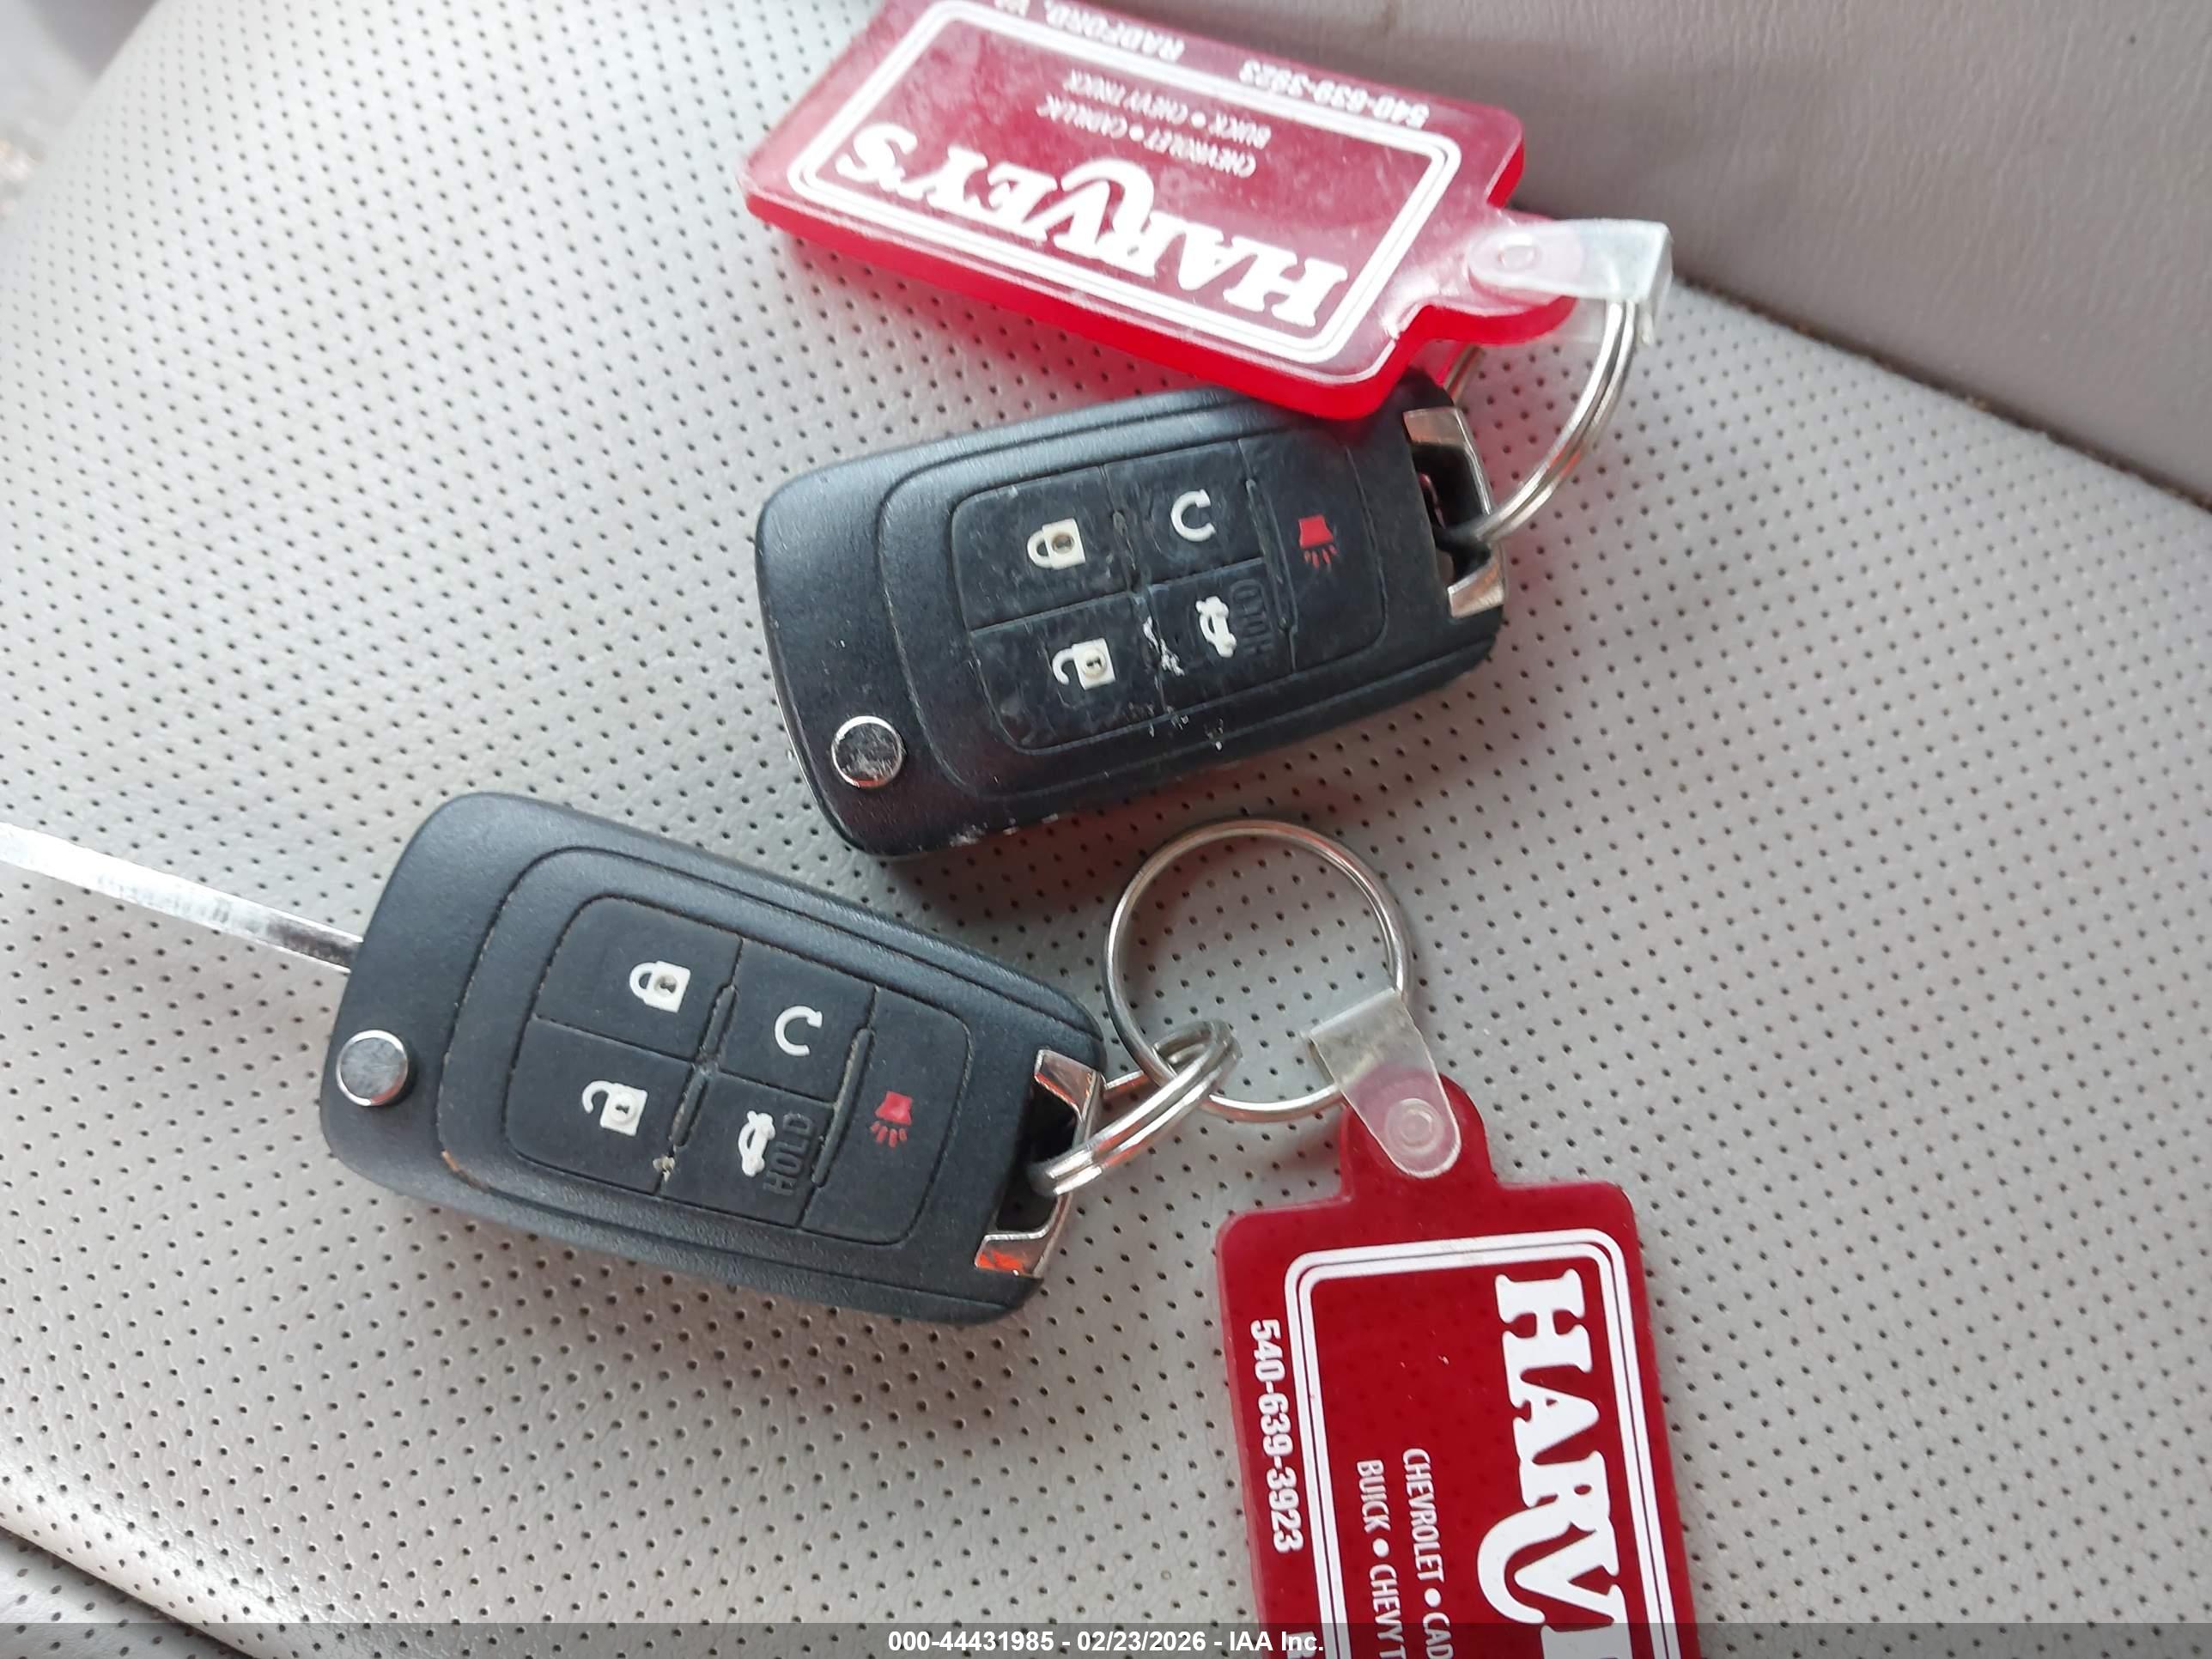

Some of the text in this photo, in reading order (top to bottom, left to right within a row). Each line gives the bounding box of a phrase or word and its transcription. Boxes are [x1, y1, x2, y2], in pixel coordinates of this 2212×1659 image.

[1036, 94, 1256, 178] CHEVROLET CADILLAC
[1063, 69, 1271, 149] BUICK CHEVY TRUCK
[836, 123, 1347, 326] HARVEY'S
[763, 1112, 812, 1196] HOLD
[1249, 1318, 1304, 1553] 540-639-3923
[1357, 1459, 1391, 1533] BUICK
[1402, 1447, 1446, 1583] CHEVROLET
[1369, 1563, 1405, 1644] CHEVY
